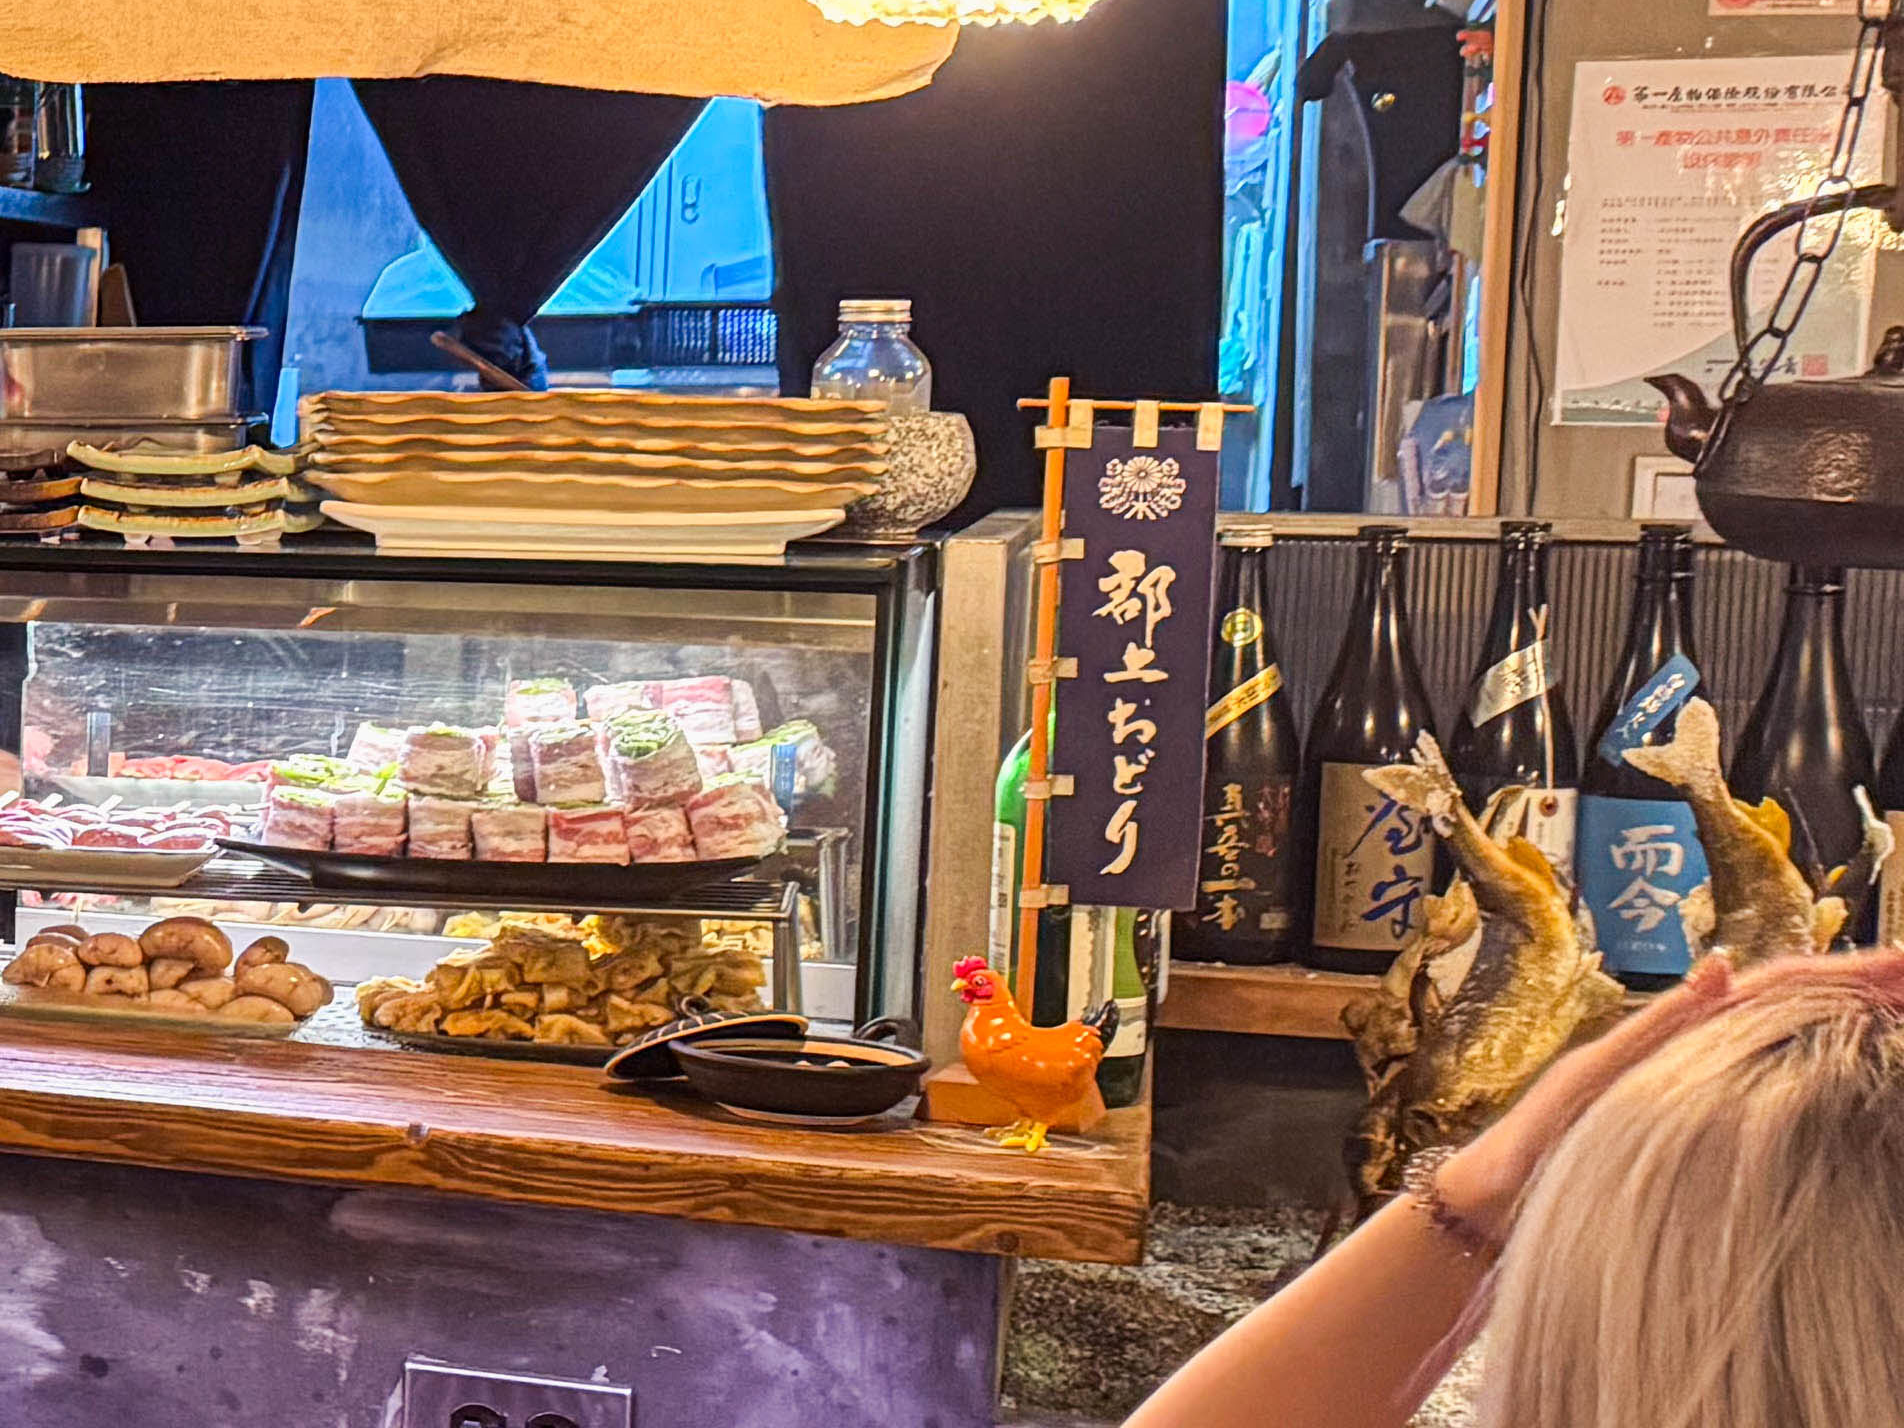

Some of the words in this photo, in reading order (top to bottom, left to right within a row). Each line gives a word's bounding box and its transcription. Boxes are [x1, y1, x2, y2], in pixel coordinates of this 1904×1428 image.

[1092, 550, 1177, 875] 郡上おどり
[1608, 824, 1686, 932] 而今
